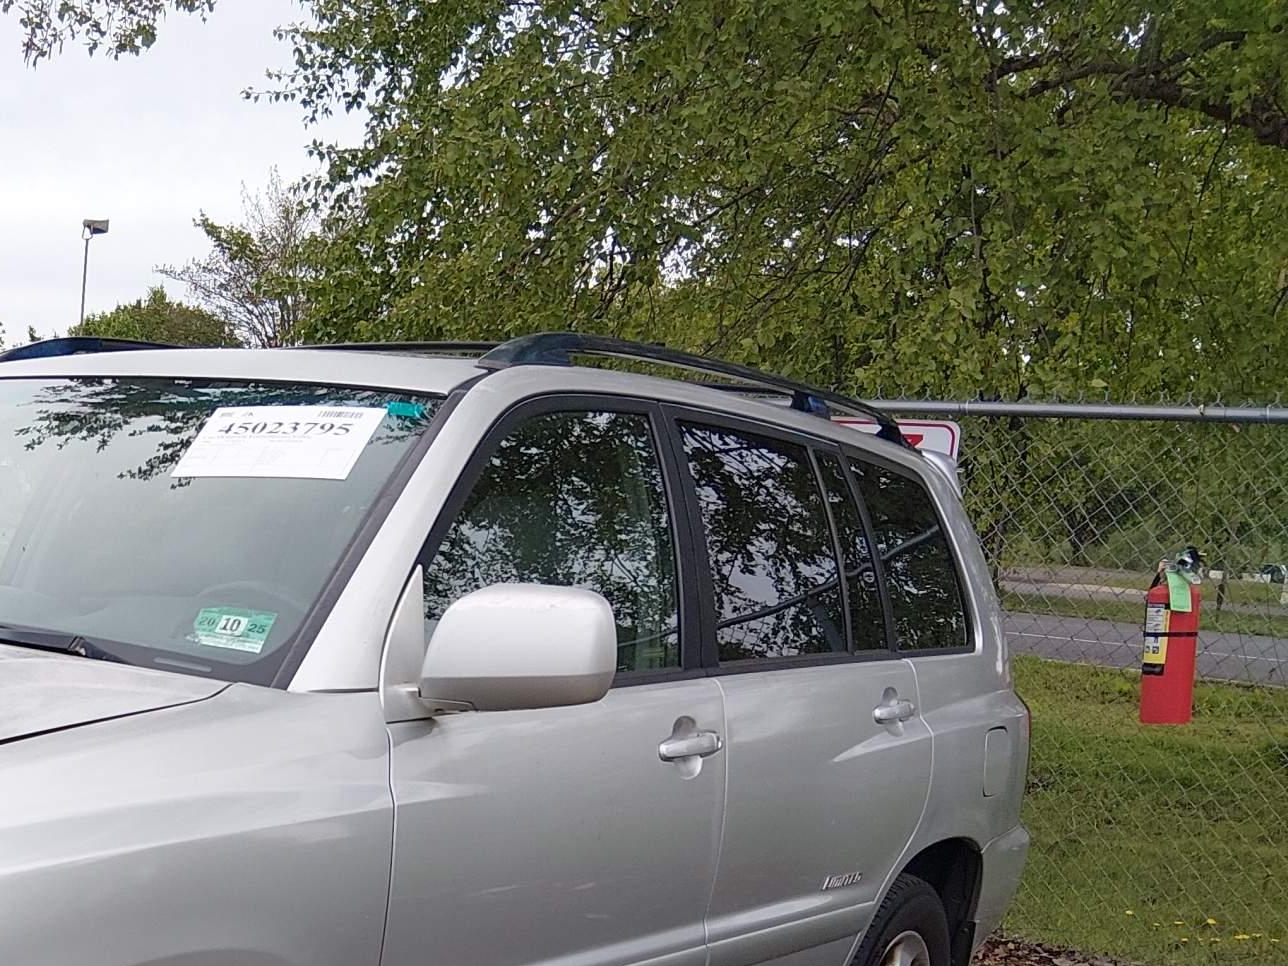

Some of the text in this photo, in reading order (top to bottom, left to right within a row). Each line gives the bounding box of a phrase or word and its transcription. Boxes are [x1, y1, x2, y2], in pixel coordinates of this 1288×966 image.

[218, 422, 354, 435] 45023795
[219, 617, 241, 632] 10
[247, 623, 267, 634] 25
